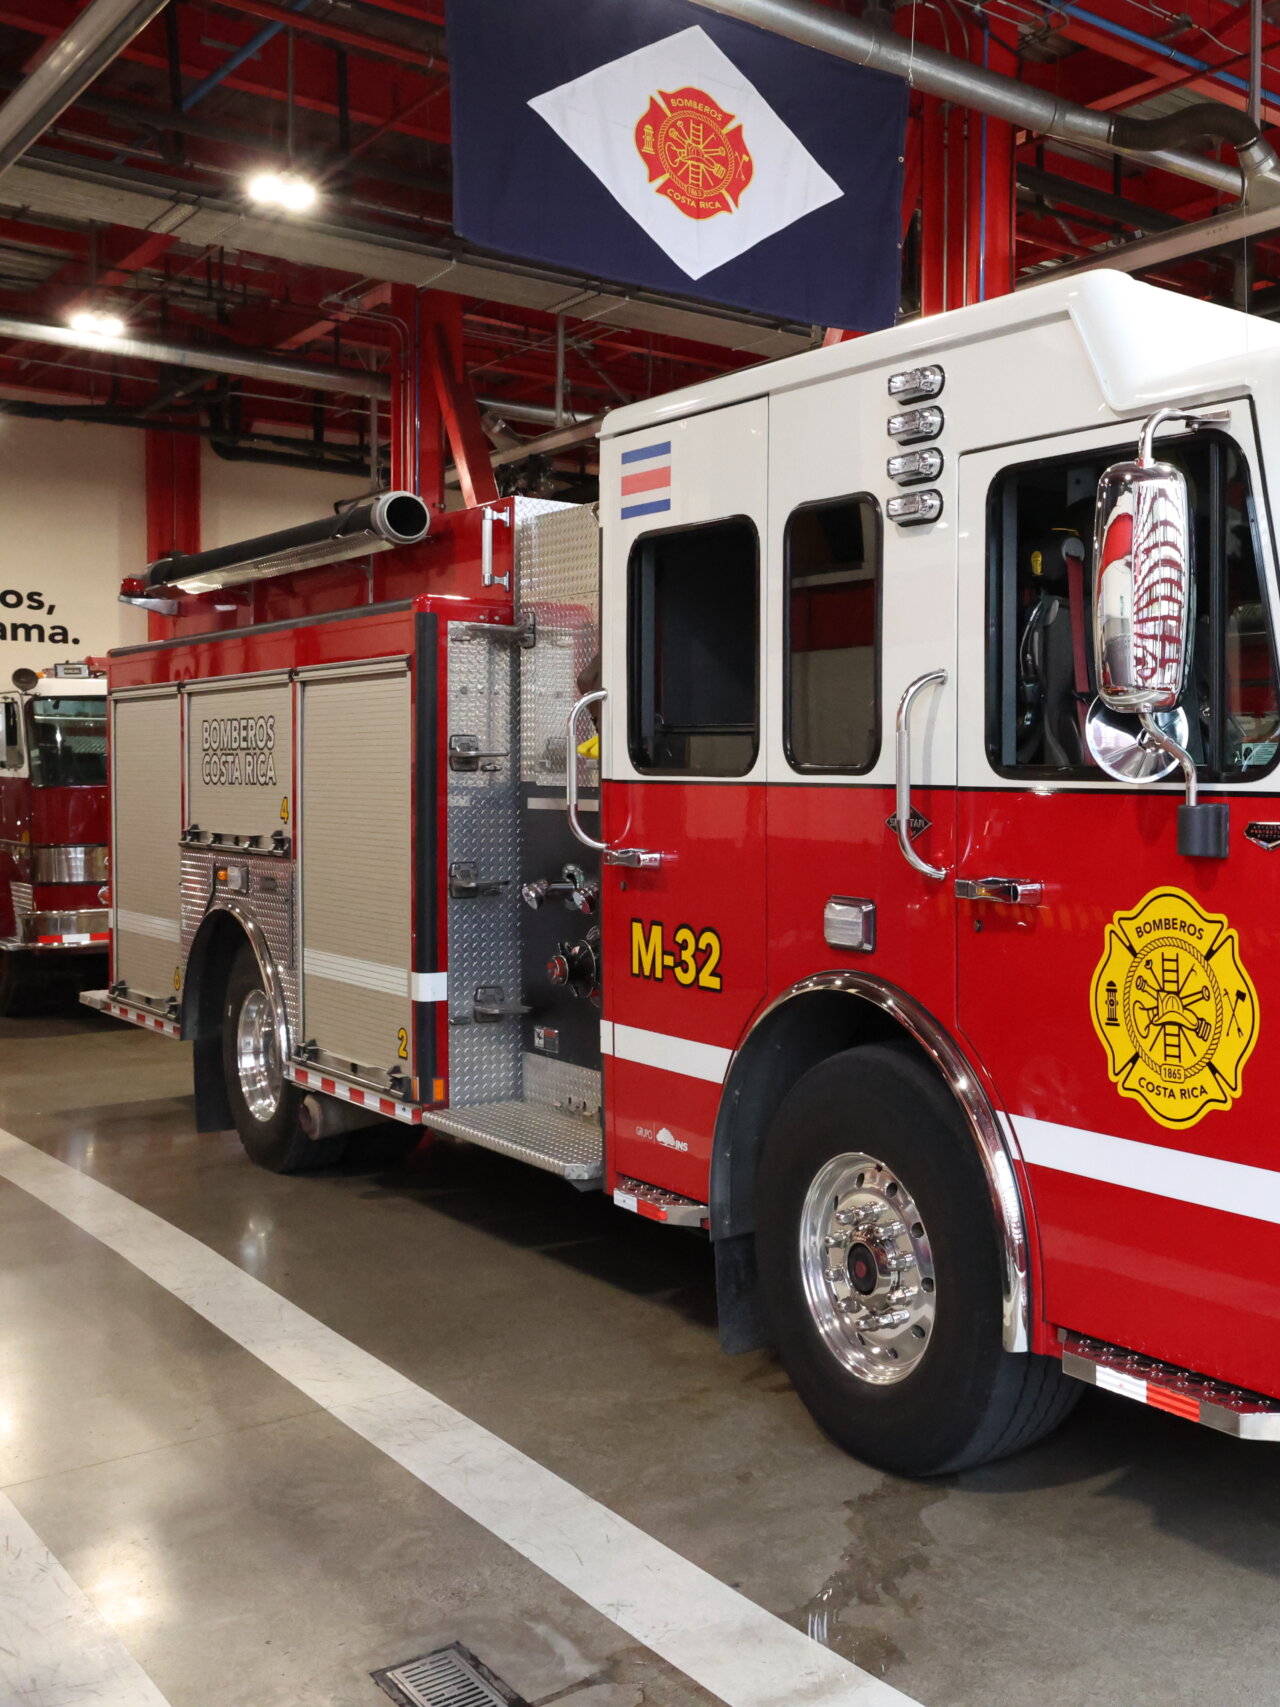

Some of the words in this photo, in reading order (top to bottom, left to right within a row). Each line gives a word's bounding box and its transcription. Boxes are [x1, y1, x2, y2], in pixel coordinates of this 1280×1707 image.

[670, 98, 722, 121] BOMBEROS
[667, 188, 697, 208] COSTA
[699, 201, 722, 209] RICA
[0, 589, 56, 615] os,
[202, 715, 275, 751] BOMBEROS
[202, 752, 242, 785] COSTA
[245, 752, 277, 786] RICA
[280, 796, 289, 824] 4
[890, 818, 925, 828] STAN
[1135, 918, 1204, 940] BOMBEROS
[631, 917, 722, 993] M-32
[173, 966, 181, 991] 6
[398, 1027, 408, 1060] 2
[1163, 1067, 1182, 1080] 1865
[1138, 1077, 1176, 1100] COSTA
[1179, 1085, 1208, 1100] RICA
[675, 1140, 688, 1152] INS
